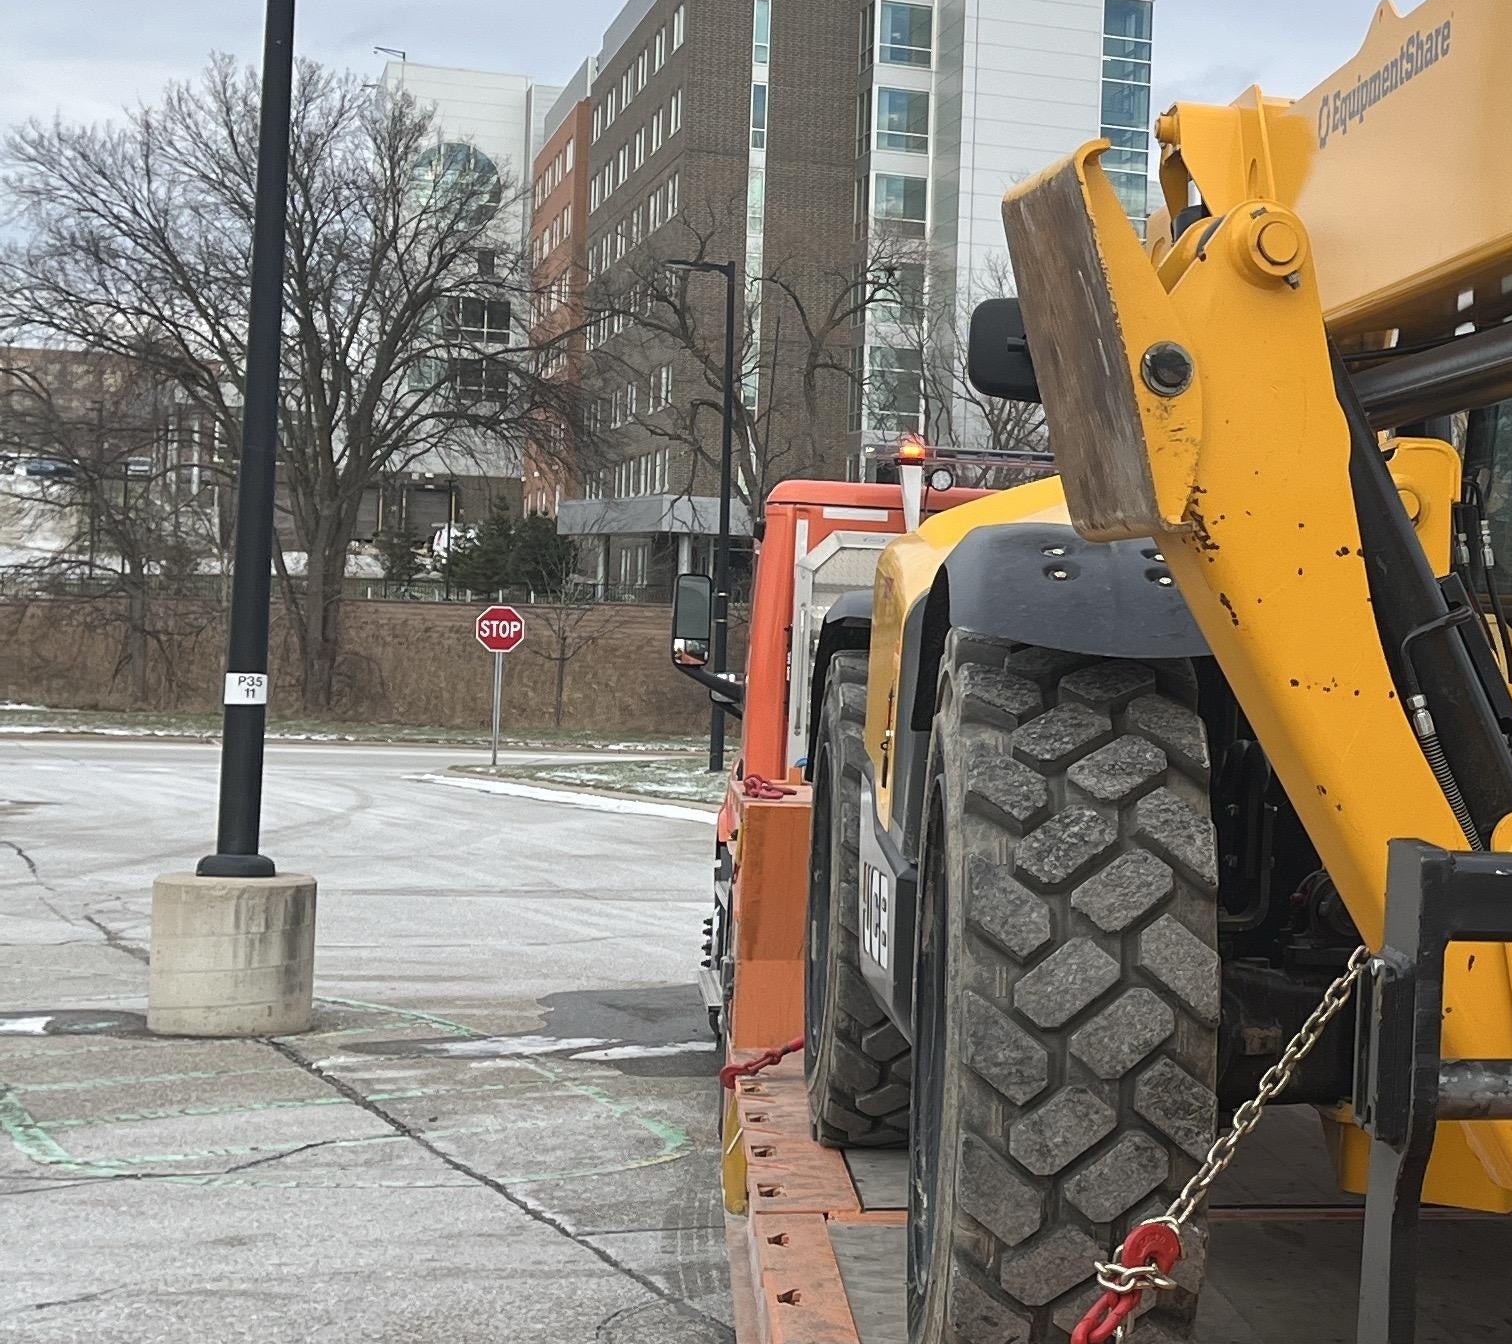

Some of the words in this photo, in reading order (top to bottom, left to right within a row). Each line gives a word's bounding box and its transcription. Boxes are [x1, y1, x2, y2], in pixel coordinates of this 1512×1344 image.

[1332, 20, 1451, 136] EquipmentShare
[479, 620, 521, 639] STOP
[238, 675, 263, 687] P35
[244, 688, 256, 698] 11
[863, 861, 889, 970] JCB
